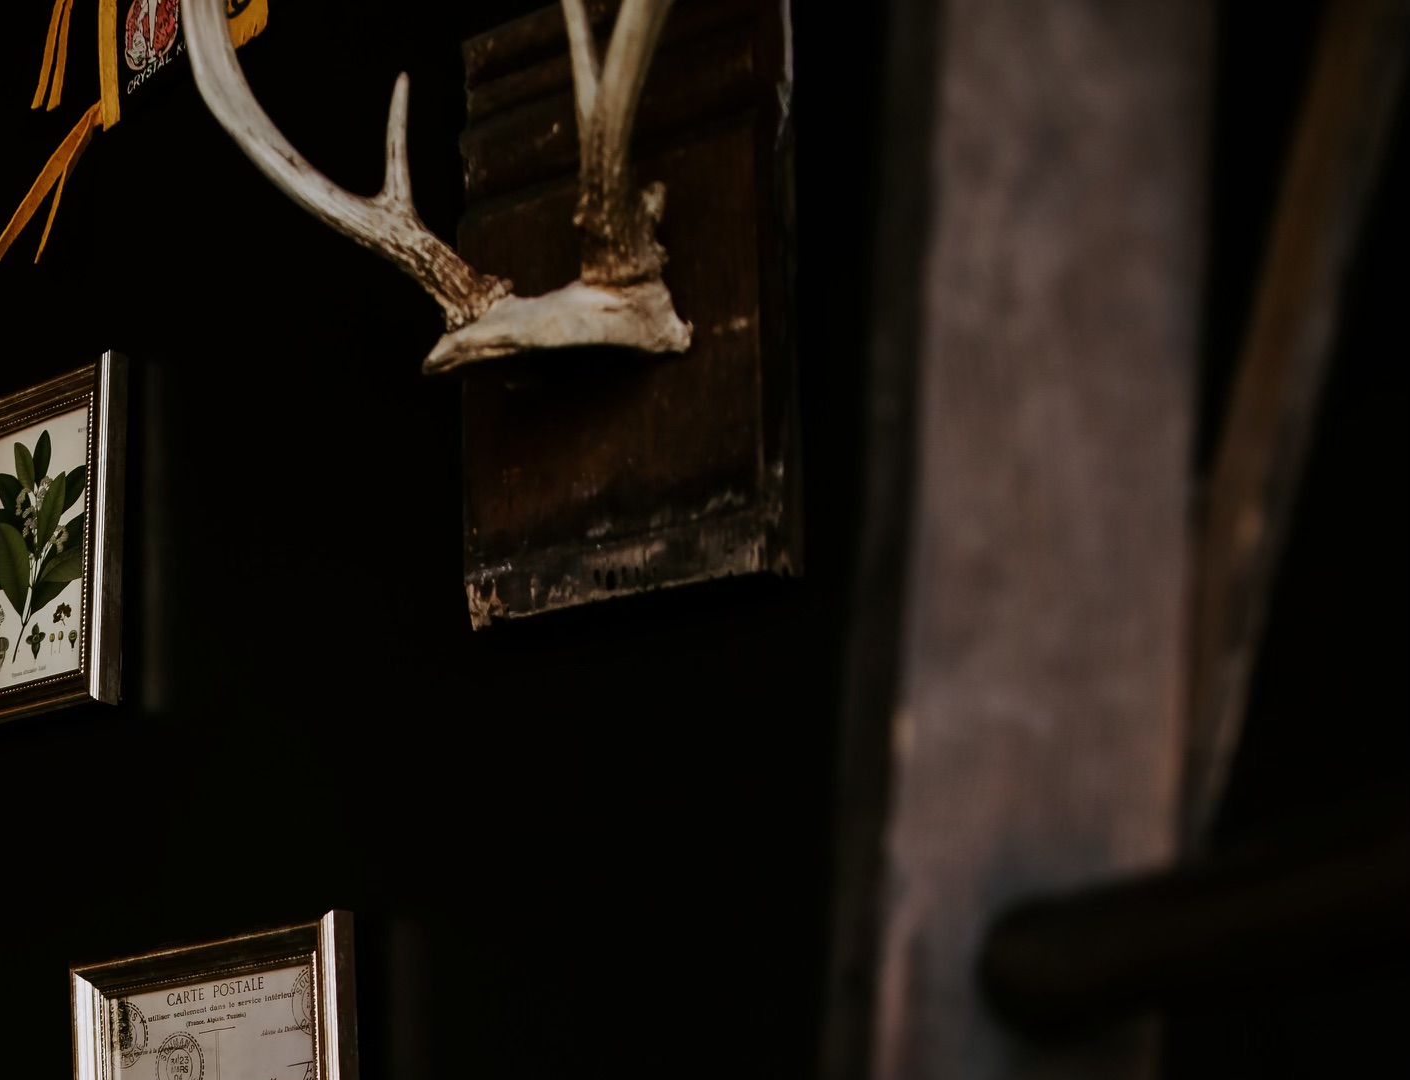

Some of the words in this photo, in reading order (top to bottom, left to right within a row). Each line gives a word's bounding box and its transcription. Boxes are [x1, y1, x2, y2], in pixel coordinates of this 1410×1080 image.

[127, 53, 172, 95] CRYSTAL
[176, 40, 187, 56] K
[147, 1012, 171, 1023] utiliser
[173, 1006, 208, 1019] seulement
[209, 1003, 226, 1013] dans
[237, 996, 262, 1008] service
[264, 990, 296, 1003] intérieur
[166, 987, 205, 1007] CARTE
[213, 976, 265, 998] POSTALE
